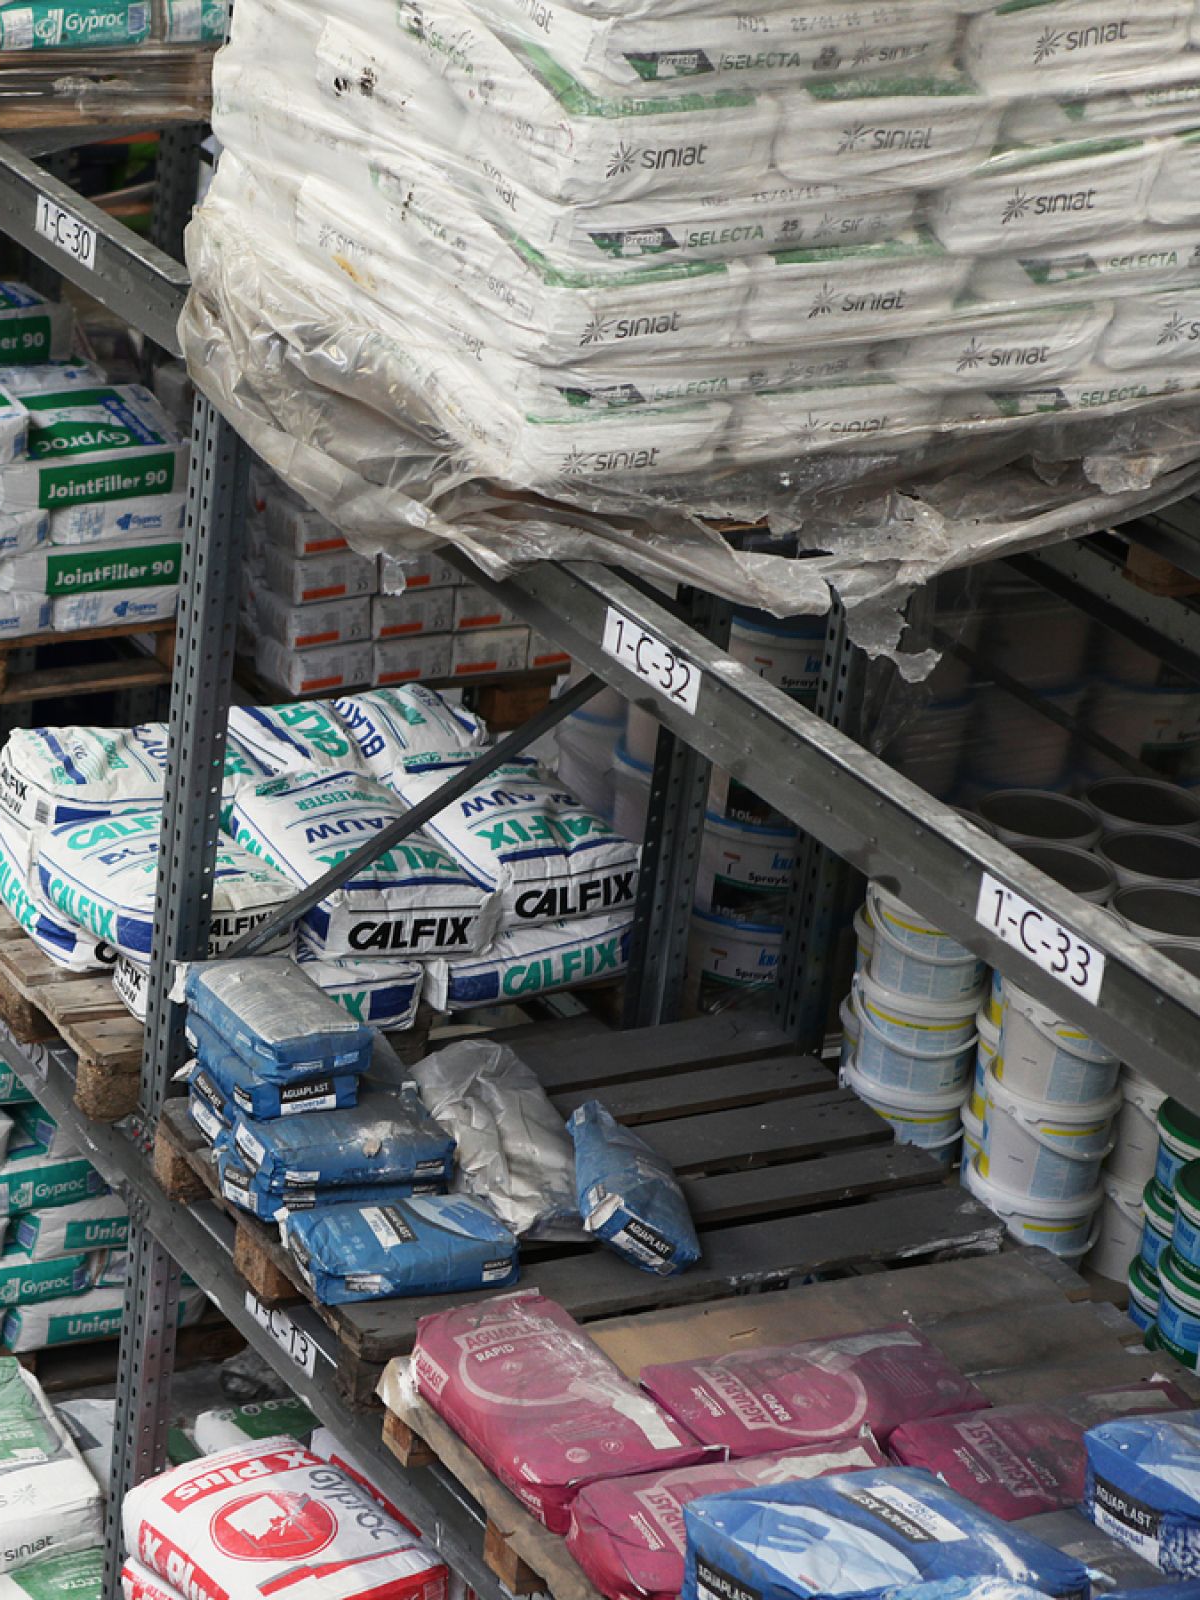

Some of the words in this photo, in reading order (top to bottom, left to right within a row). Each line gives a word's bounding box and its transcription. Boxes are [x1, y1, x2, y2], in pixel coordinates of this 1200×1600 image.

[65, 11, 125, 34] Gyproc
[1065, 19, 1130, 51] siniat
[721, 52, 800, 70] SELECTA
[871, 126, 932, 150] siniat
[640, 143, 708, 170] siniat
[1034, 188, 1096, 214] siniat
[42, 200, 91, 261] 1-C-30
[687, 225, 764, 248] SELECTA
[841, 288, 907, 313] siniat
[615, 311, 681, 340] siniat
[23, 331, 44, 347] 90
[987, 345, 1050, 367] siniat
[1080, 385, 1148, 407] SELECTA
[37, 431, 131, 451] Gyproc
[594, 447, 660, 471] siniat
[47, 474, 141, 500] JointFiller
[144, 470, 168, 487] 90
[55, 563, 147, 588] JointFiller
[151, 559, 175, 577] 90
[614, 619, 692, 703] 1-C-32
[67, 814, 162, 850] CALF
[514, 872, 634, 920] CALFIX
[51, 878, 116, 944] CALFIX
[348, 915, 472, 951] CALFIX
[994, 889, 1091, 988] 1-C-33
[503, 938, 619, 997] CALFIX
[35, 1177, 85, 1199] Gyproc
[85, 1220, 129, 1242] Uniq
[21, 1273, 70, 1295] Gyproc
[67, 1314, 122, 1337] Uniqu
[277, 1450, 318, 1469] X
[173, 1461, 273, 1502] Plus
[307, 1468, 400, 1543] Gyproc
[4, 1535, 54, 1563] siniat
